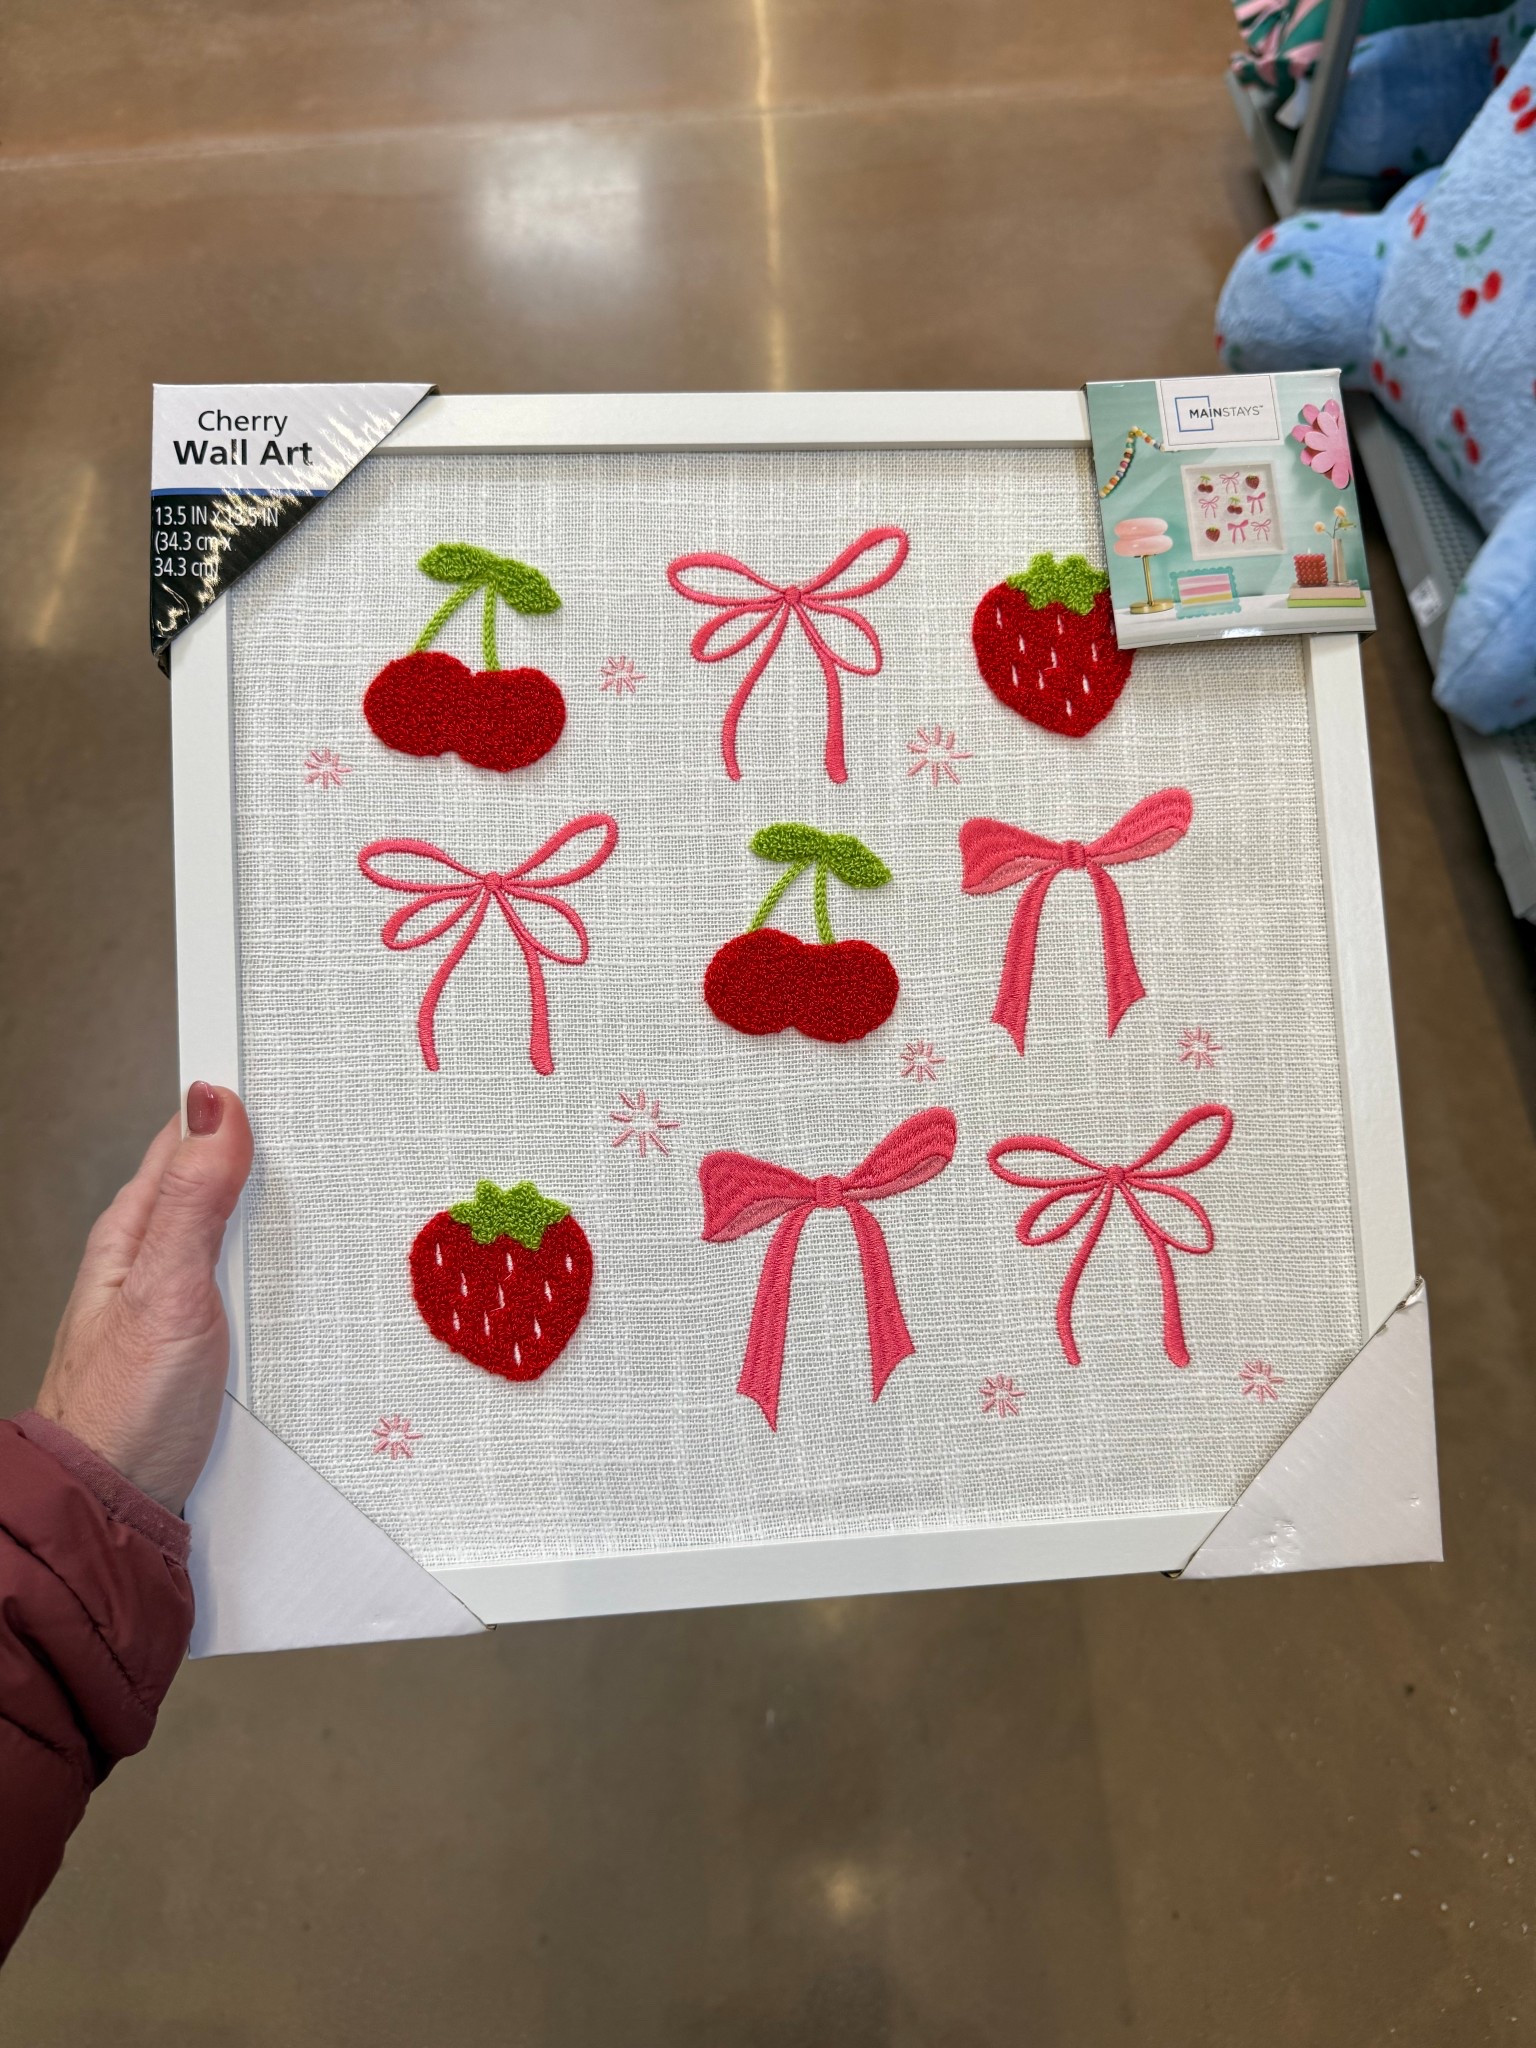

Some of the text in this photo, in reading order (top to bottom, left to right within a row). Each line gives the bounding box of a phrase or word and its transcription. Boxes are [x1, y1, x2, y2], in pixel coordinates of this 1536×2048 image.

[198, 409, 288, 437] Cherry
[173, 439, 313, 466] Wall Art
[155, 506, 187, 526] 13.5
[191, 506, 208, 526] IN
[155, 531, 232, 554] (34.3 cm x
[154, 557, 187, 577] 34.3
